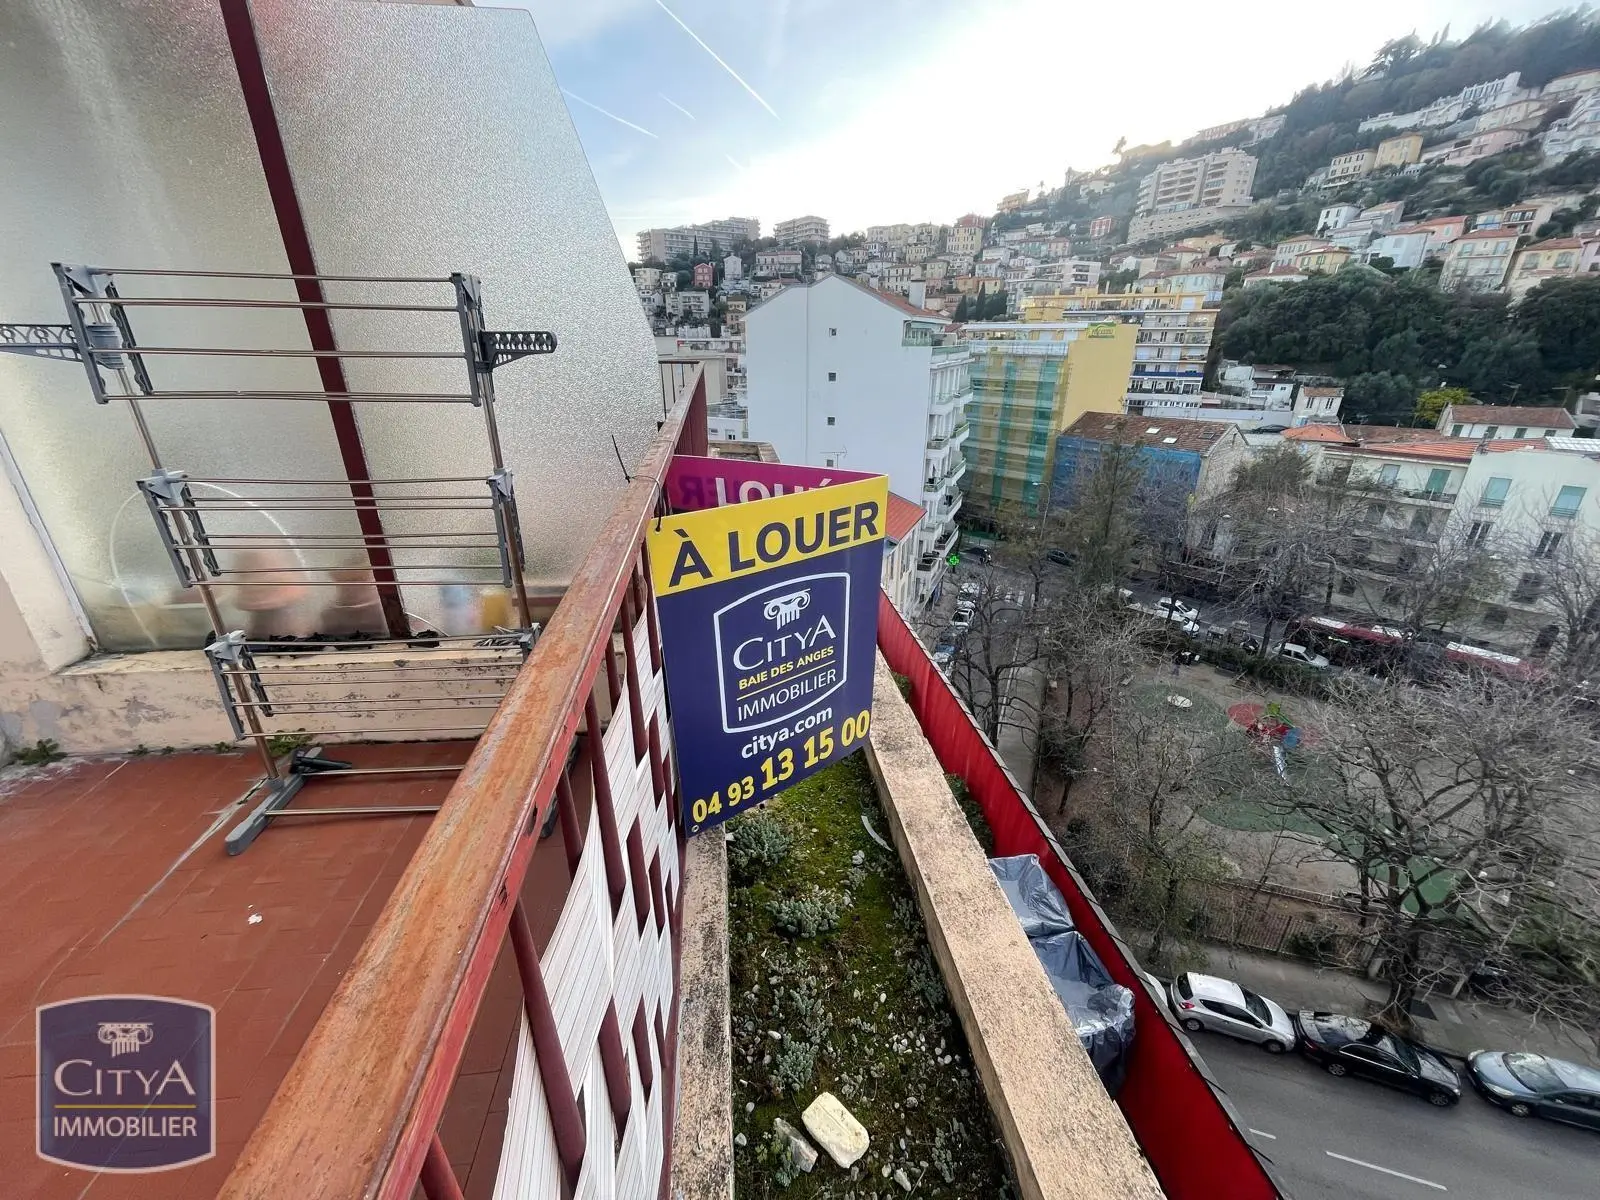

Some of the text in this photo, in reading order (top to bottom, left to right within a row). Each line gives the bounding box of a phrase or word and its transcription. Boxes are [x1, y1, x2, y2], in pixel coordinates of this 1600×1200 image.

[715, 477, 832, 507] LO
[668, 501, 879, 588] À LOUER
[739, 646, 834, 690] BAIE DES ANGES
[738, 669, 836, 722] IMMOBILIER
[741, 706, 833, 759] citya.com
[692, 709, 870, 823] 04 93 13 15 00
